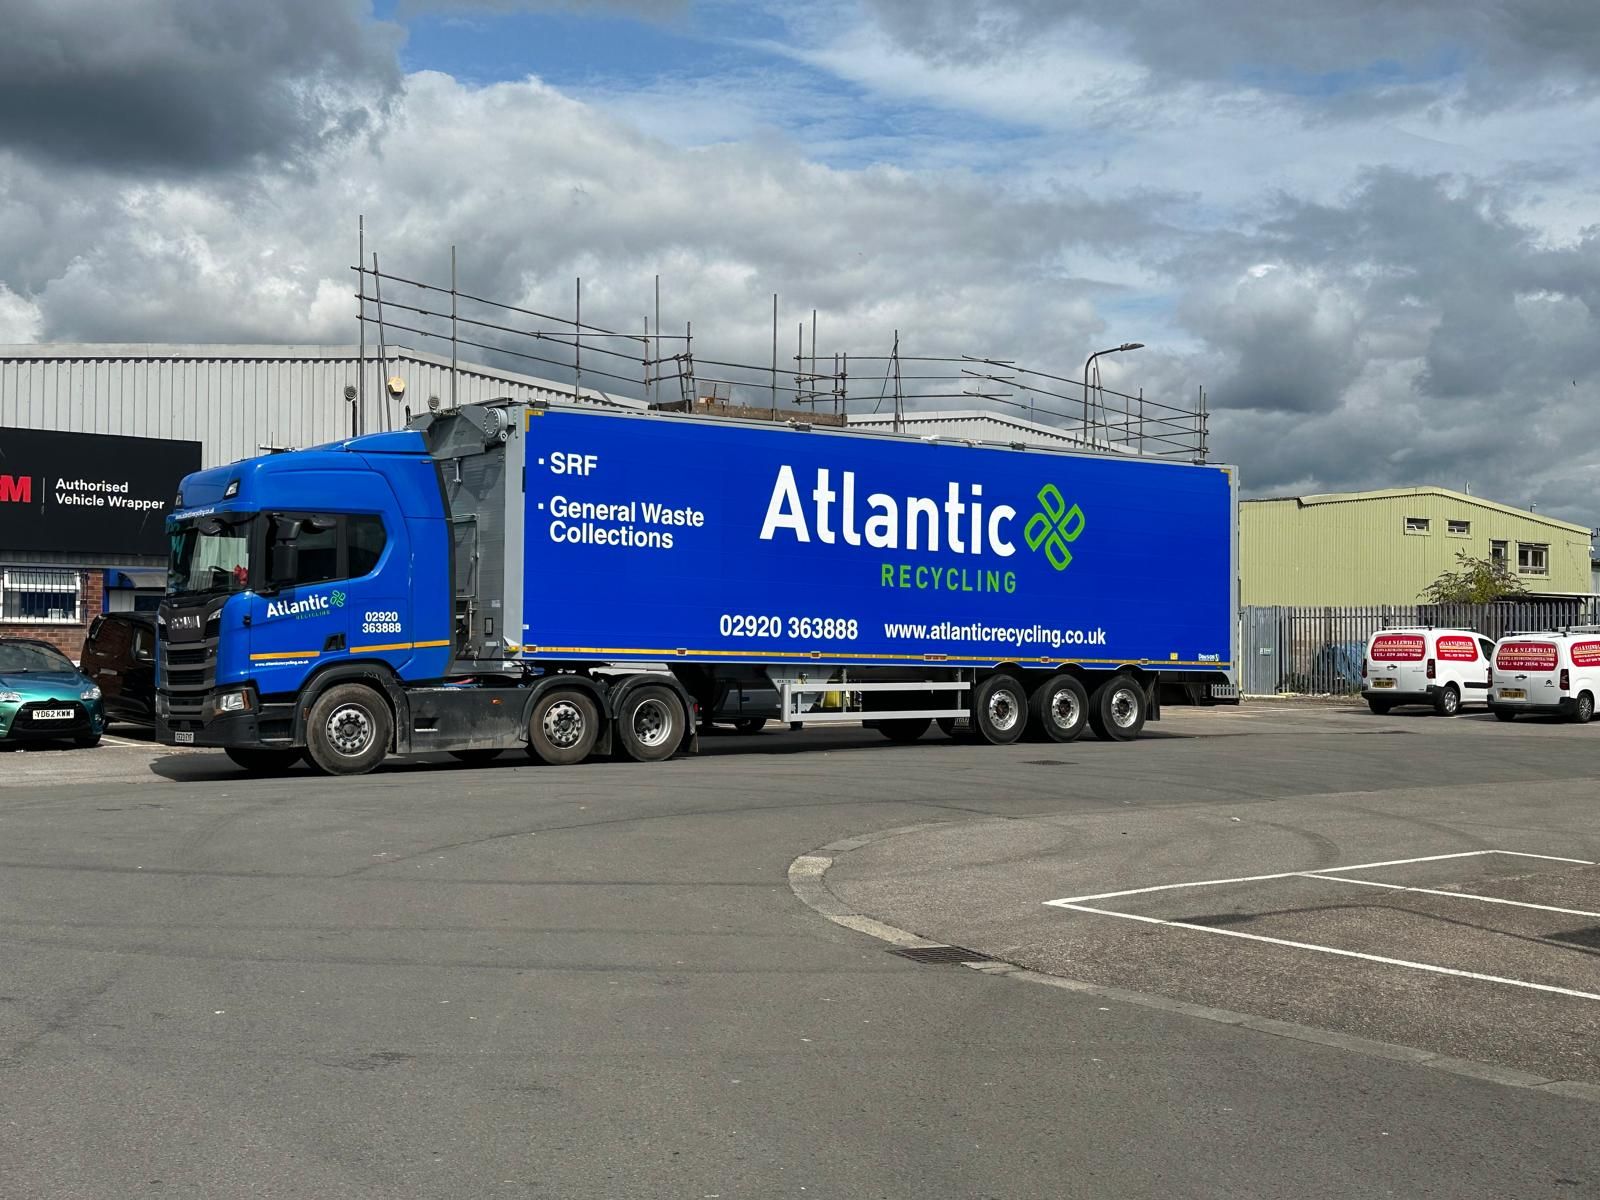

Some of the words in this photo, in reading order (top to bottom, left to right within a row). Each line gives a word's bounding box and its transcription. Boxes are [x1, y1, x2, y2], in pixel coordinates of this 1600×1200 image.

[550, 451, 598, 476] SRF
[0, 475, 31, 502] M
[56, 478, 129, 493] Authorised
[56, 493, 105, 506] Vehicle
[108, 496, 165, 511] Wrapper
[550, 495, 636, 522] General
[641, 502, 705, 527] Waste
[759, 464, 1017, 558] Atlantic
[550, 520, 674, 549] Collections
[881, 563, 1017, 593] RECYCLING
[266, 594, 329, 618] Atlantic
[365, 611, 398, 622] 02920
[362, 622, 402, 633] 363888
[719, 614, 782, 638] 02920
[787, 616, 859, 640] 363888
[884, 621, 1106, 649] www.atlanticrecycling.co.uk
[36, 710, 56, 718] YD62
